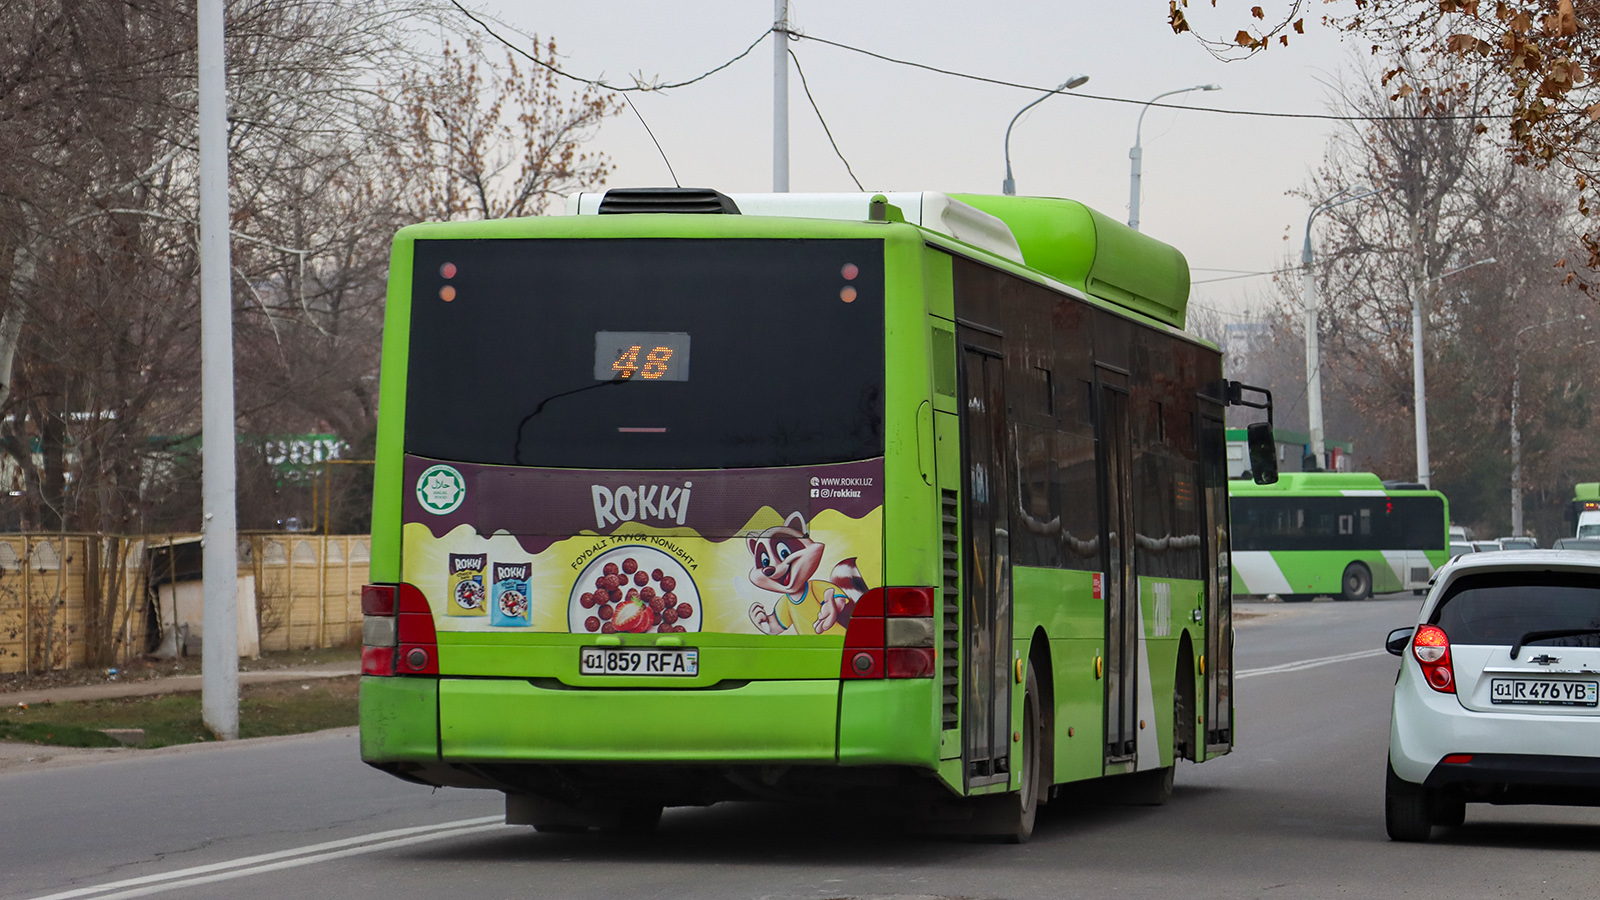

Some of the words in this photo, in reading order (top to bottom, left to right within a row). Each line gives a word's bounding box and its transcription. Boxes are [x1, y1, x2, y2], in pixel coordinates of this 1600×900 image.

[611, 345, 674, 379] 48
[820, 477, 873, 486] WWW.ROKKI.UZ
[571, 540, 607, 570] FOYDALI
[609, 534, 647, 544] TAYYOR
[651, 536, 698, 570] NONUSHTA
[586, 655, 602, 668] 01
[607, 653, 641, 672] 859
[647, 654, 685, 672] RFA
[1496, 684, 1511, 696] 01
[1515, 682, 1526, 698] R
[1530, 683, 1560, 698] 476
[1564, 684, 1586, 699] YB
